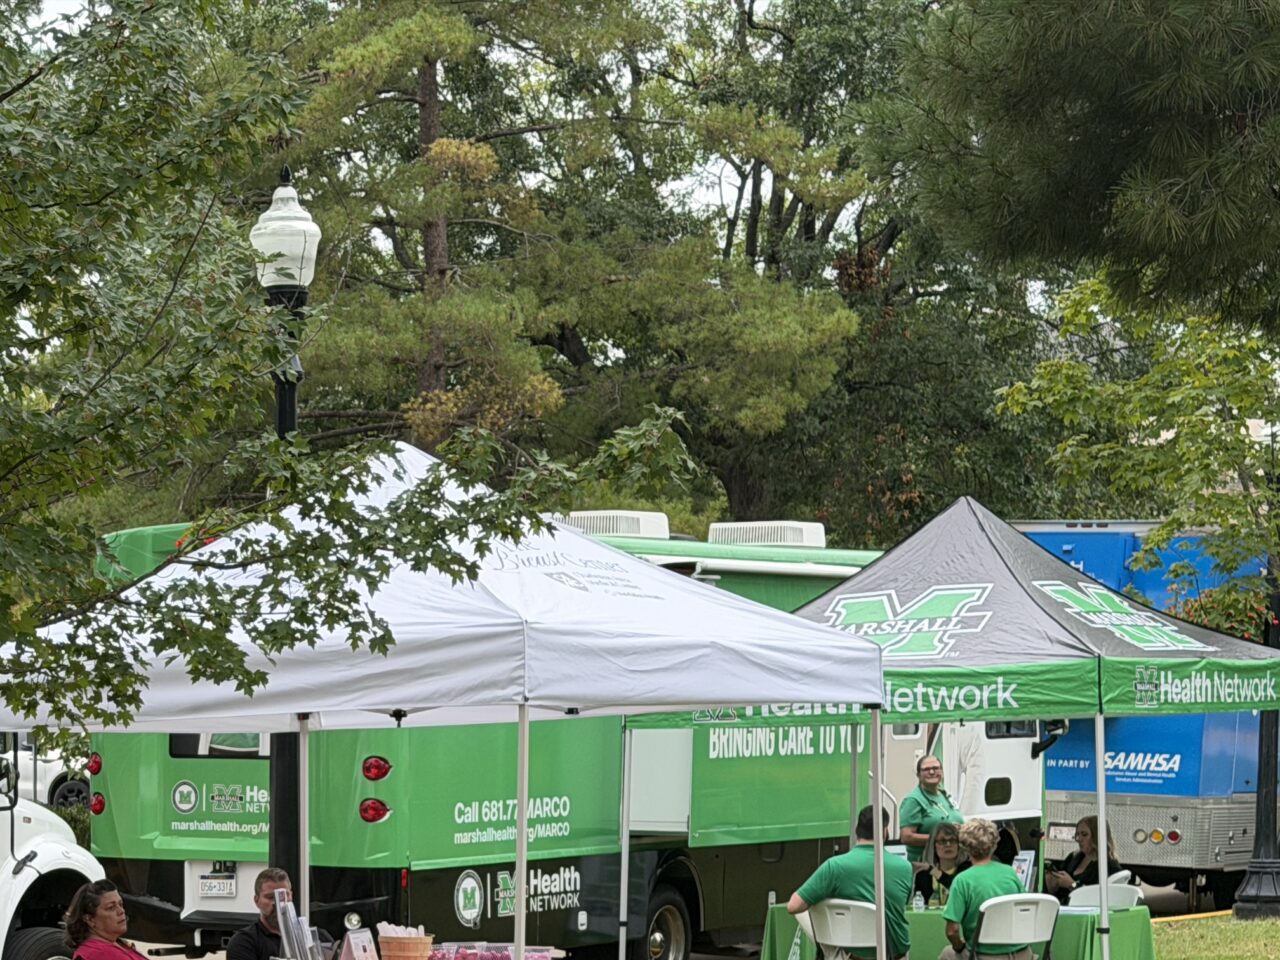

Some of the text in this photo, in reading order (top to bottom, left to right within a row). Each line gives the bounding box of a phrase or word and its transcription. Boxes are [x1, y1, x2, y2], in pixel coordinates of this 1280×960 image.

[1160, 670, 1277, 703] Health Network
[1047, 759, 1090, 769] IN PART BY
[1104, 752, 1181, 772] SAMHSA
[246, 786, 270, 802] He
[246, 803, 270, 813] NET
[454, 802, 479, 824] Call
[530, 866, 580, 896] Health
[530, 892, 580, 912] NETWORK
